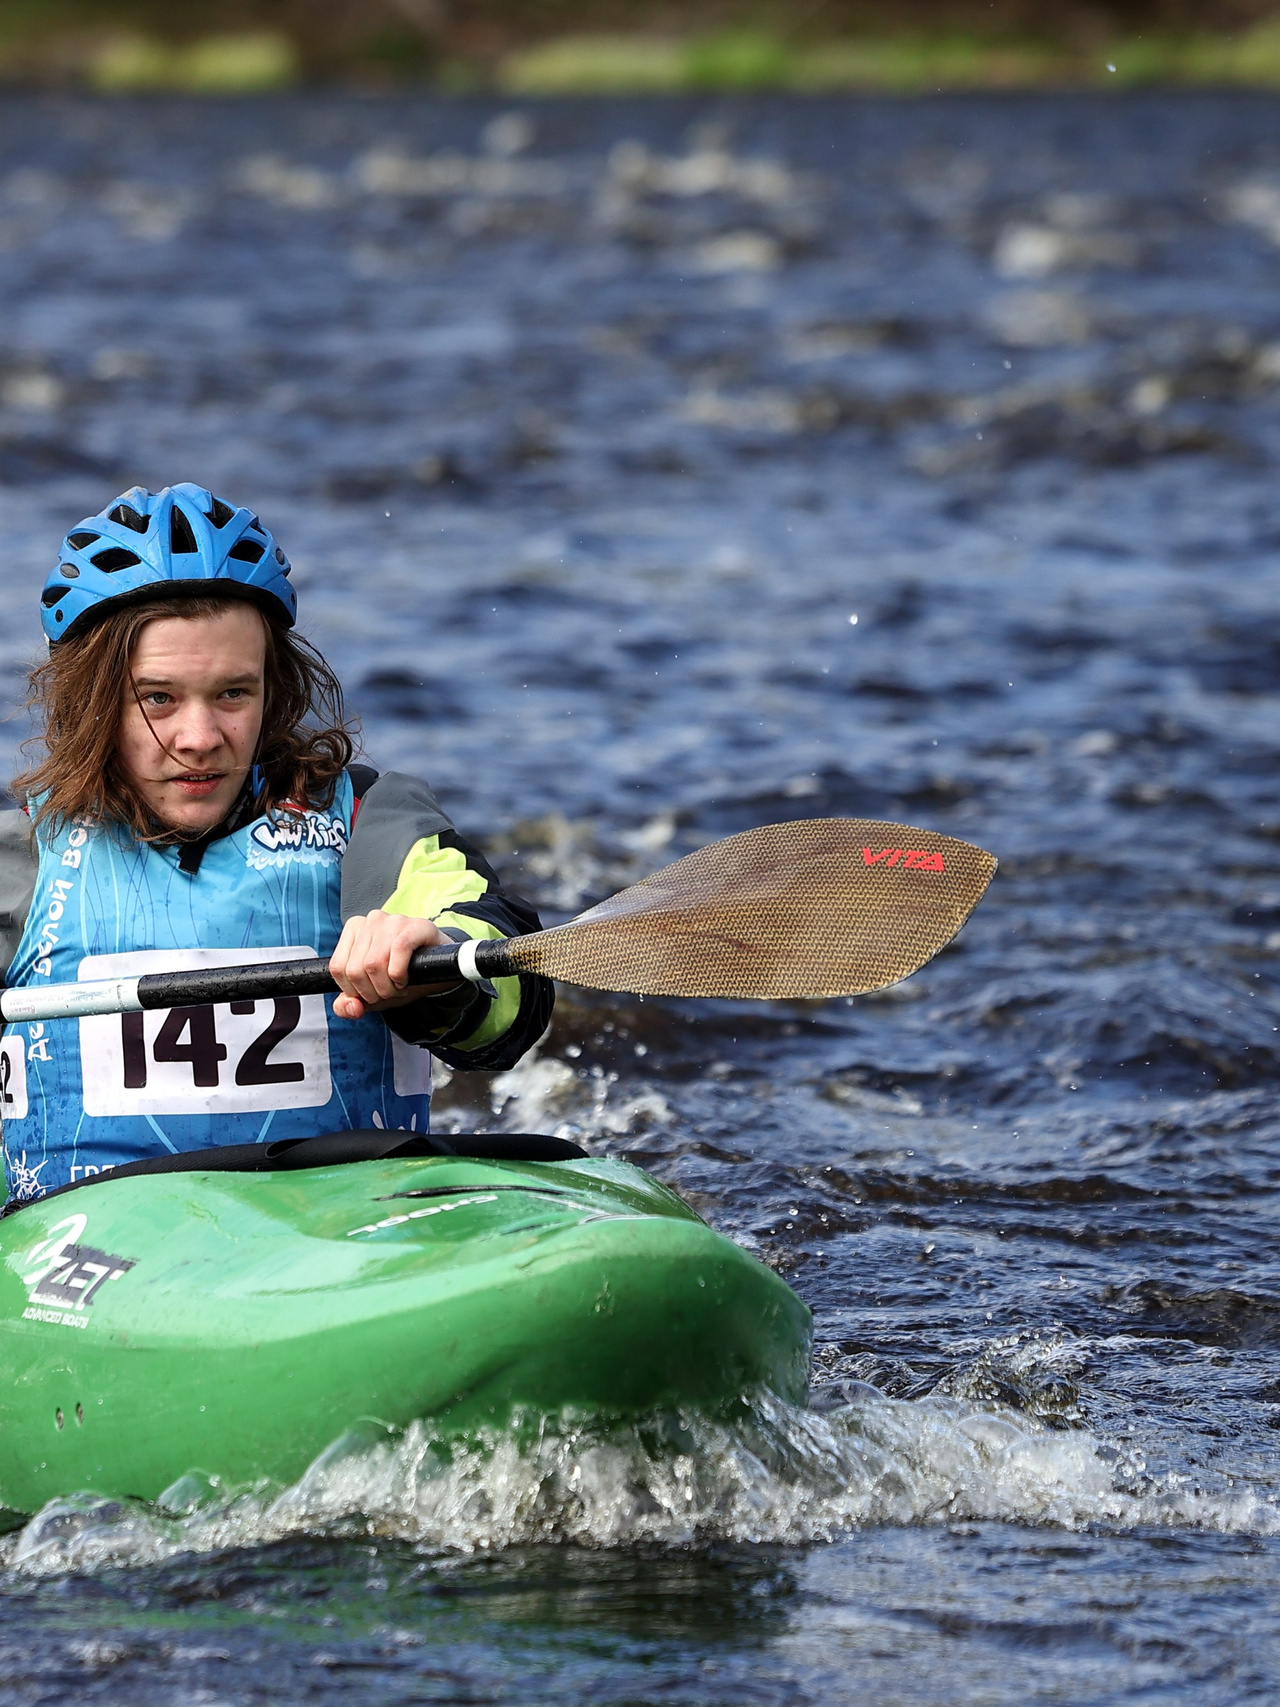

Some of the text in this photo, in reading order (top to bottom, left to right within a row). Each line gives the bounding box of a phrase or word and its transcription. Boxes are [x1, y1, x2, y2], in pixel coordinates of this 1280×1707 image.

[862, 847, 945, 872] VITA
[121, 995, 305, 1089] 142
[22, 1307, 90, 1329] ADVANCED BOATS
